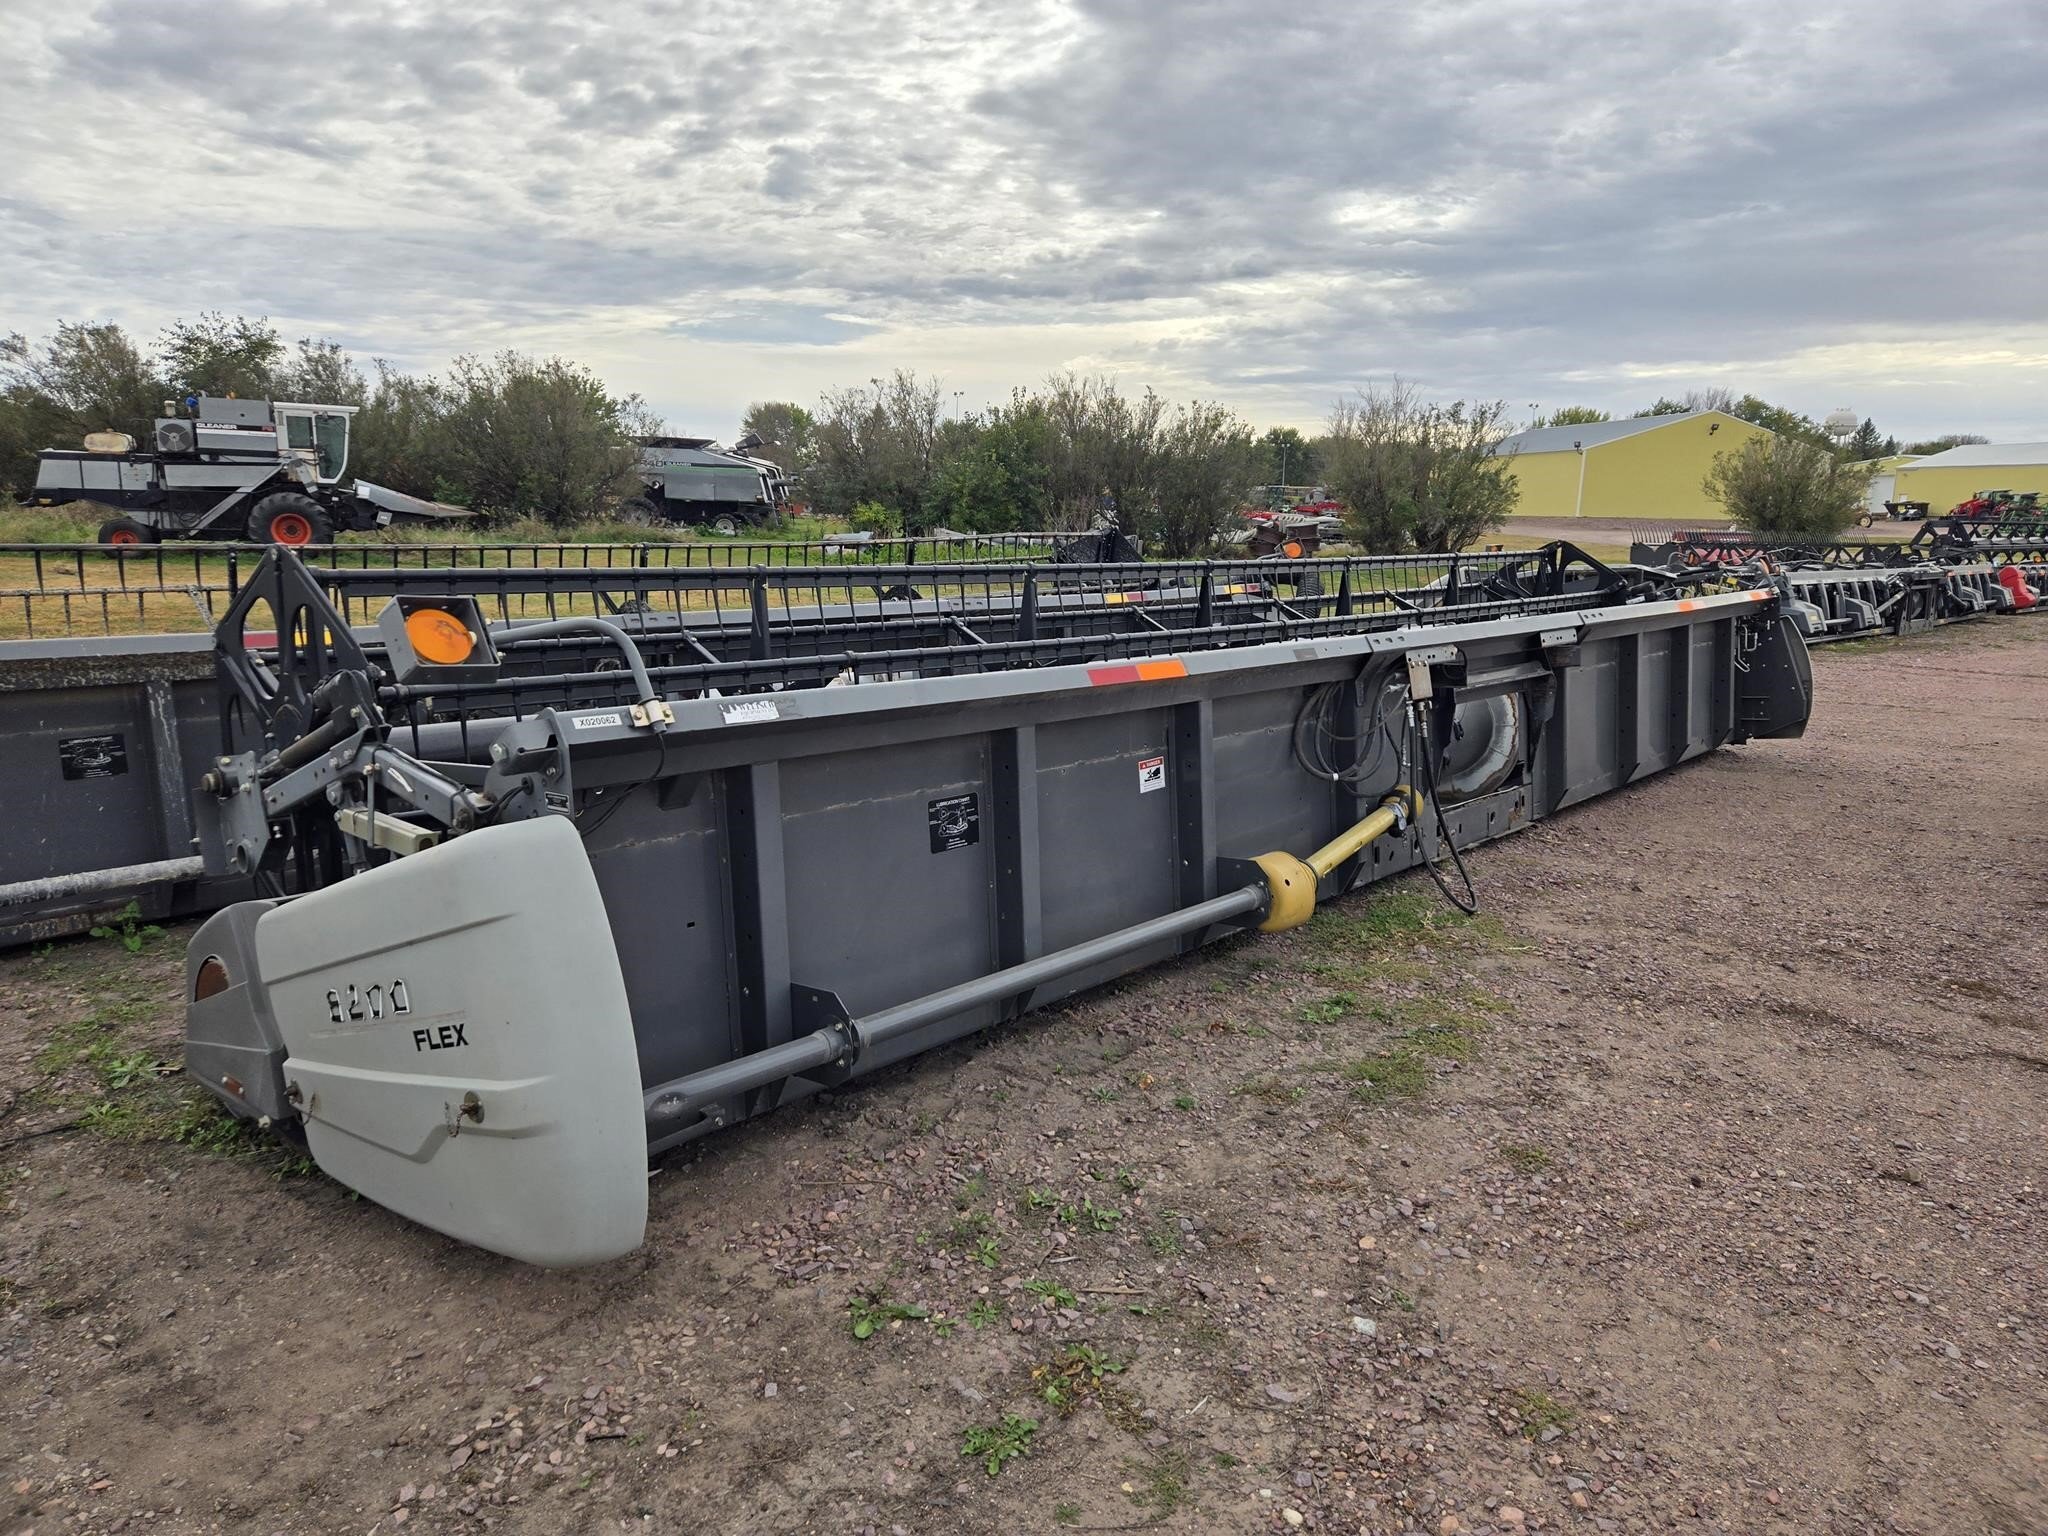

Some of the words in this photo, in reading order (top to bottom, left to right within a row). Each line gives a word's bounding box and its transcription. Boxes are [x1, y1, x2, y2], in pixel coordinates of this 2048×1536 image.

[580, 716, 616, 727] X020062
[326, 978, 411, 1023] 8200
[413, 1023, 469, 1051] FLEX
